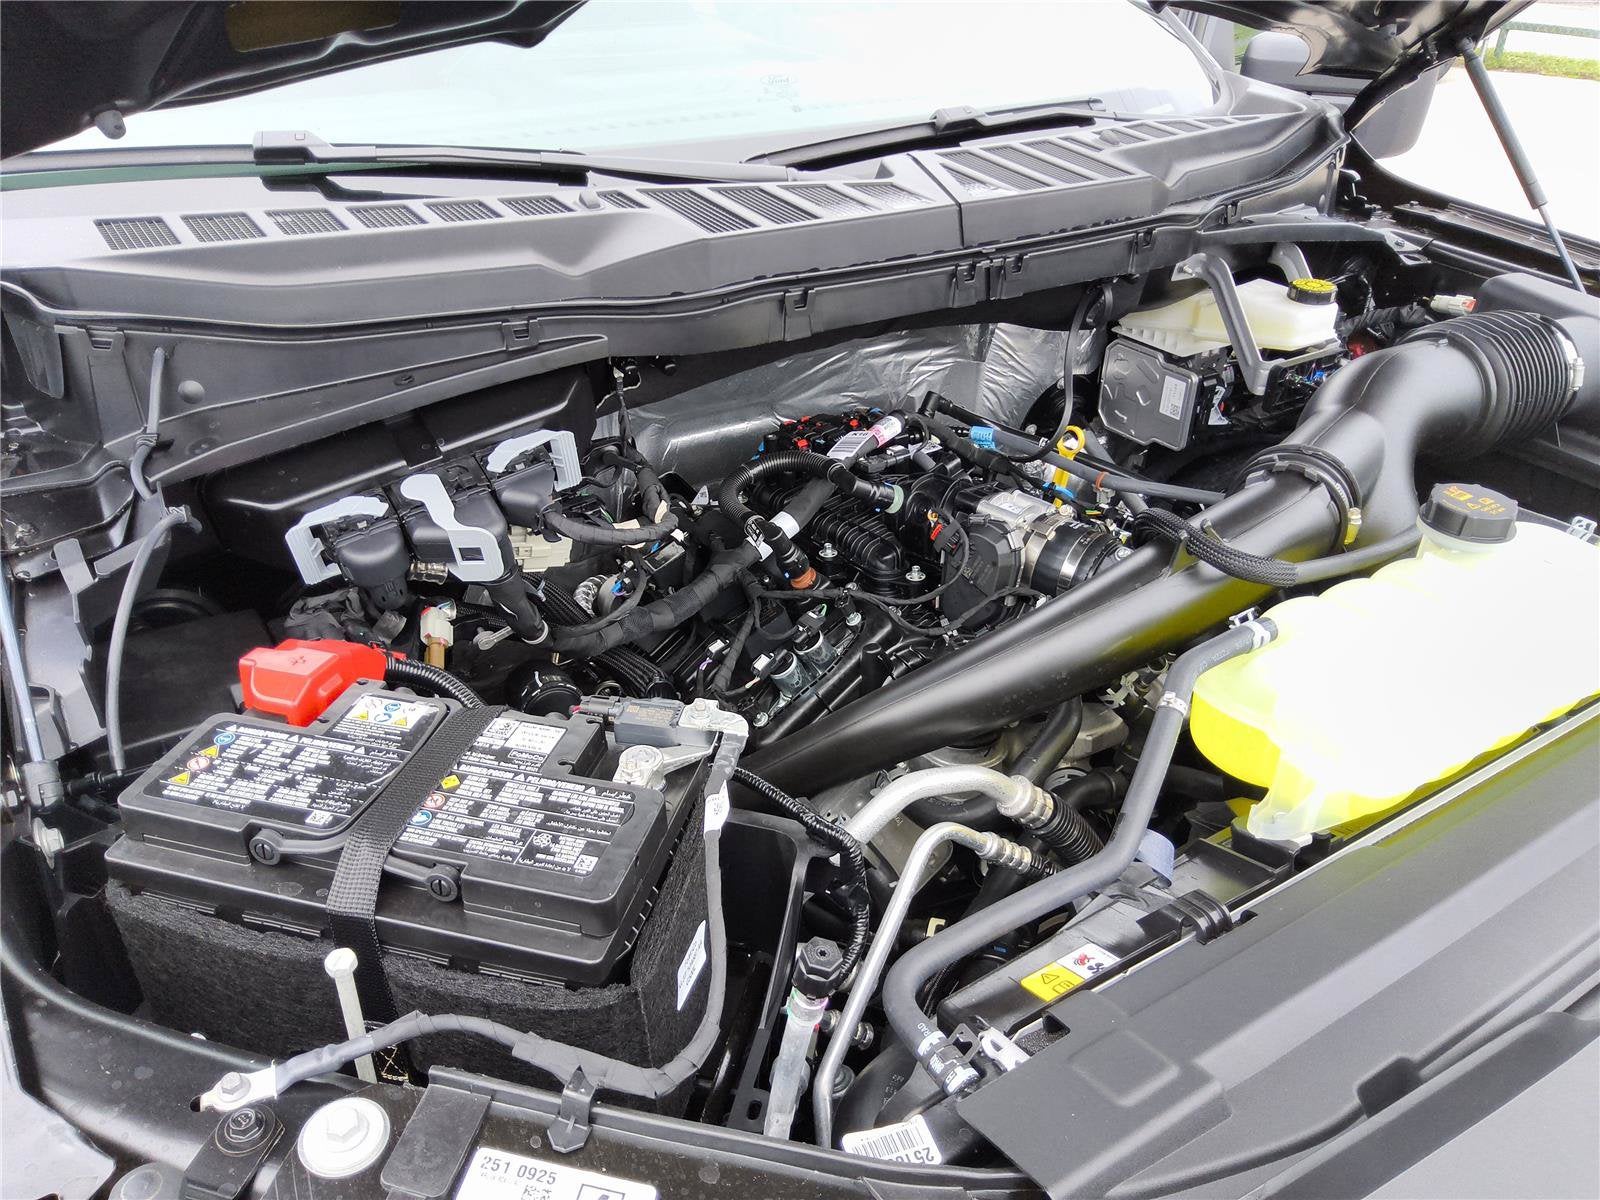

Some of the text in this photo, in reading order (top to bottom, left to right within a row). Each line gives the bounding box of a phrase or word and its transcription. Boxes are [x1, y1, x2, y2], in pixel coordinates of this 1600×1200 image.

[511, 752, 544, 761] FoMoCo
[481, 1157, 510, 1174] 251
[516, 1164, 557, 1185] 0925
